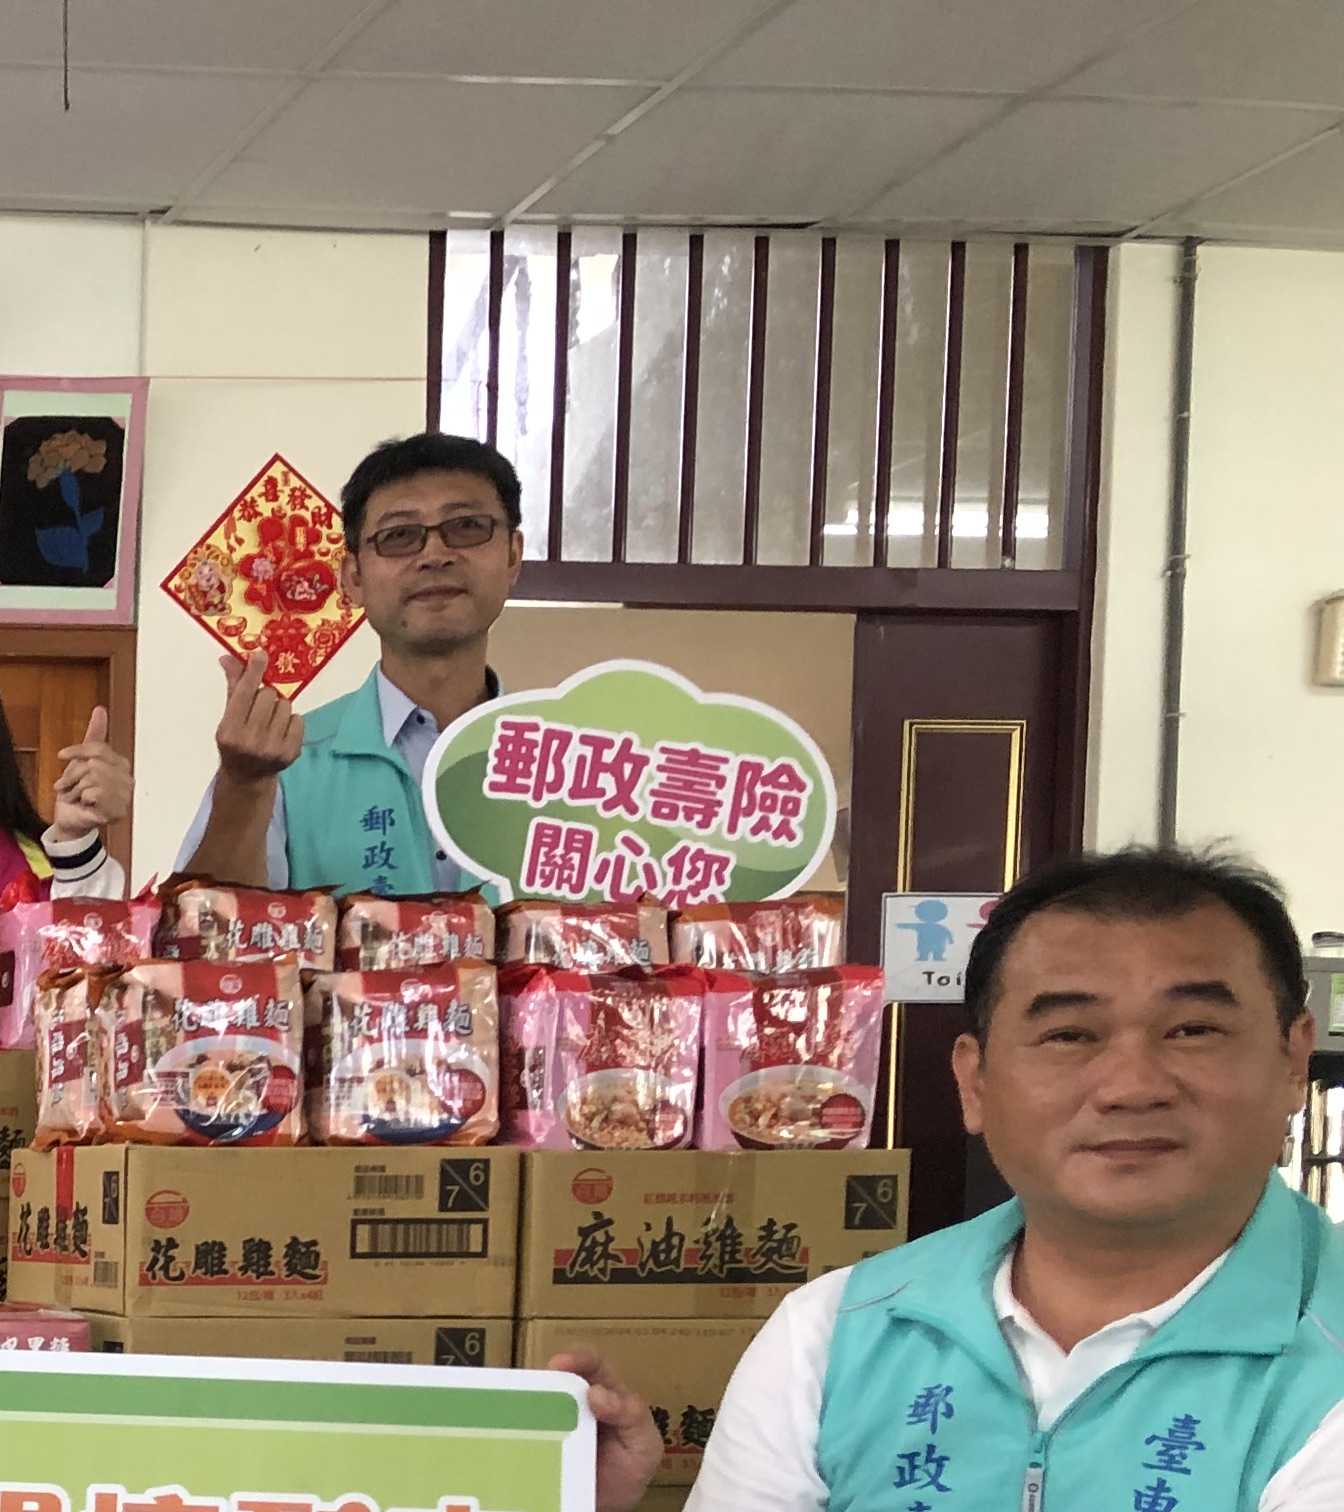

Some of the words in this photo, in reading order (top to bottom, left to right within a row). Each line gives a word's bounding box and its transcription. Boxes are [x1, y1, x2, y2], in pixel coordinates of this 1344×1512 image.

[484, 717, 812, 849] 郵政壽險
[921, 969, 964, 987] Toi
[145, 1235, 324, 1283] 花雕雞麵
[566, 1211, 805, 1279] 麻油雞麵
